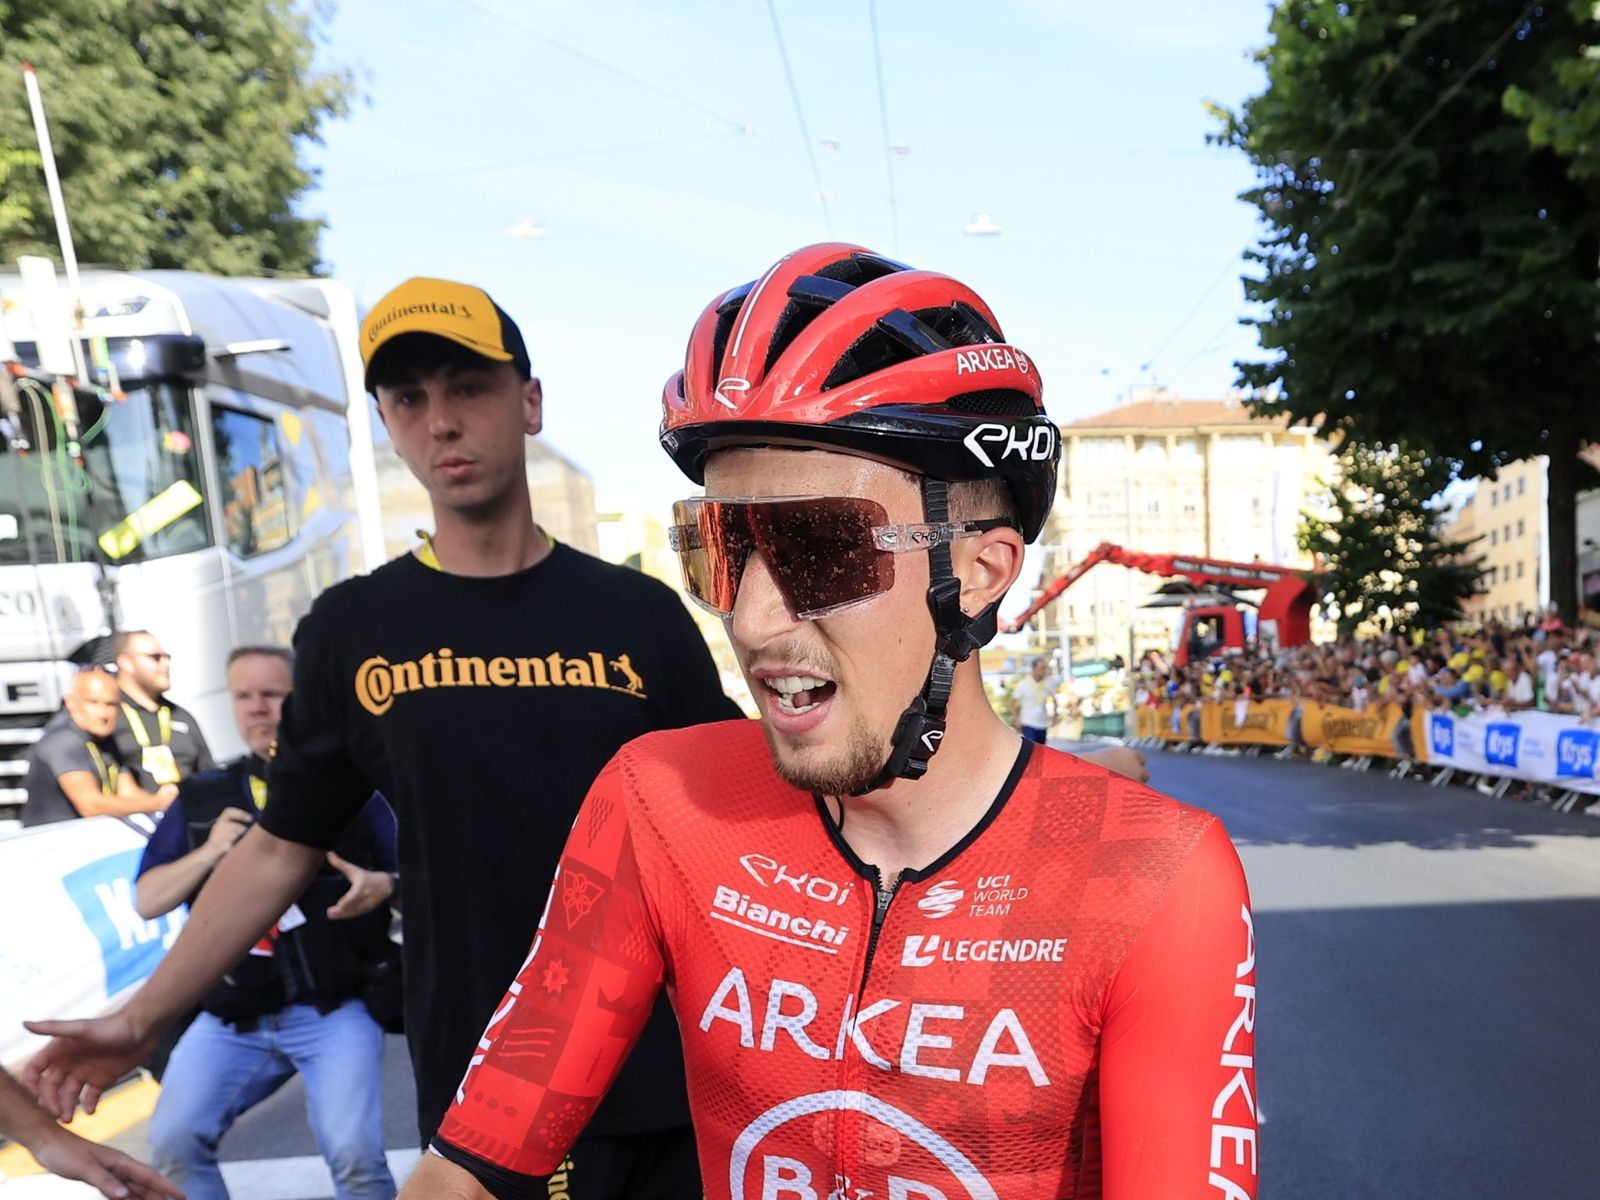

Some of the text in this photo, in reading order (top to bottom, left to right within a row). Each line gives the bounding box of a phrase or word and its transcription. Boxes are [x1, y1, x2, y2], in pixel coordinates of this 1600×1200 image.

[368, 302, 456, 342] Continental
[956, 348, 1017, 376] ARKEA
[354, 647, 611, 717] Continental
[973, 887, 1029, 904] WORLD
[976, 874, 1011, 890] UCI
[712, 884, 850, 946] Bianchi
[968, 903, 1011, 918] TEAM
[941, 937, 1069, 963] LEGENDRE
[698, 966, 1052, 1088] ARKEA
